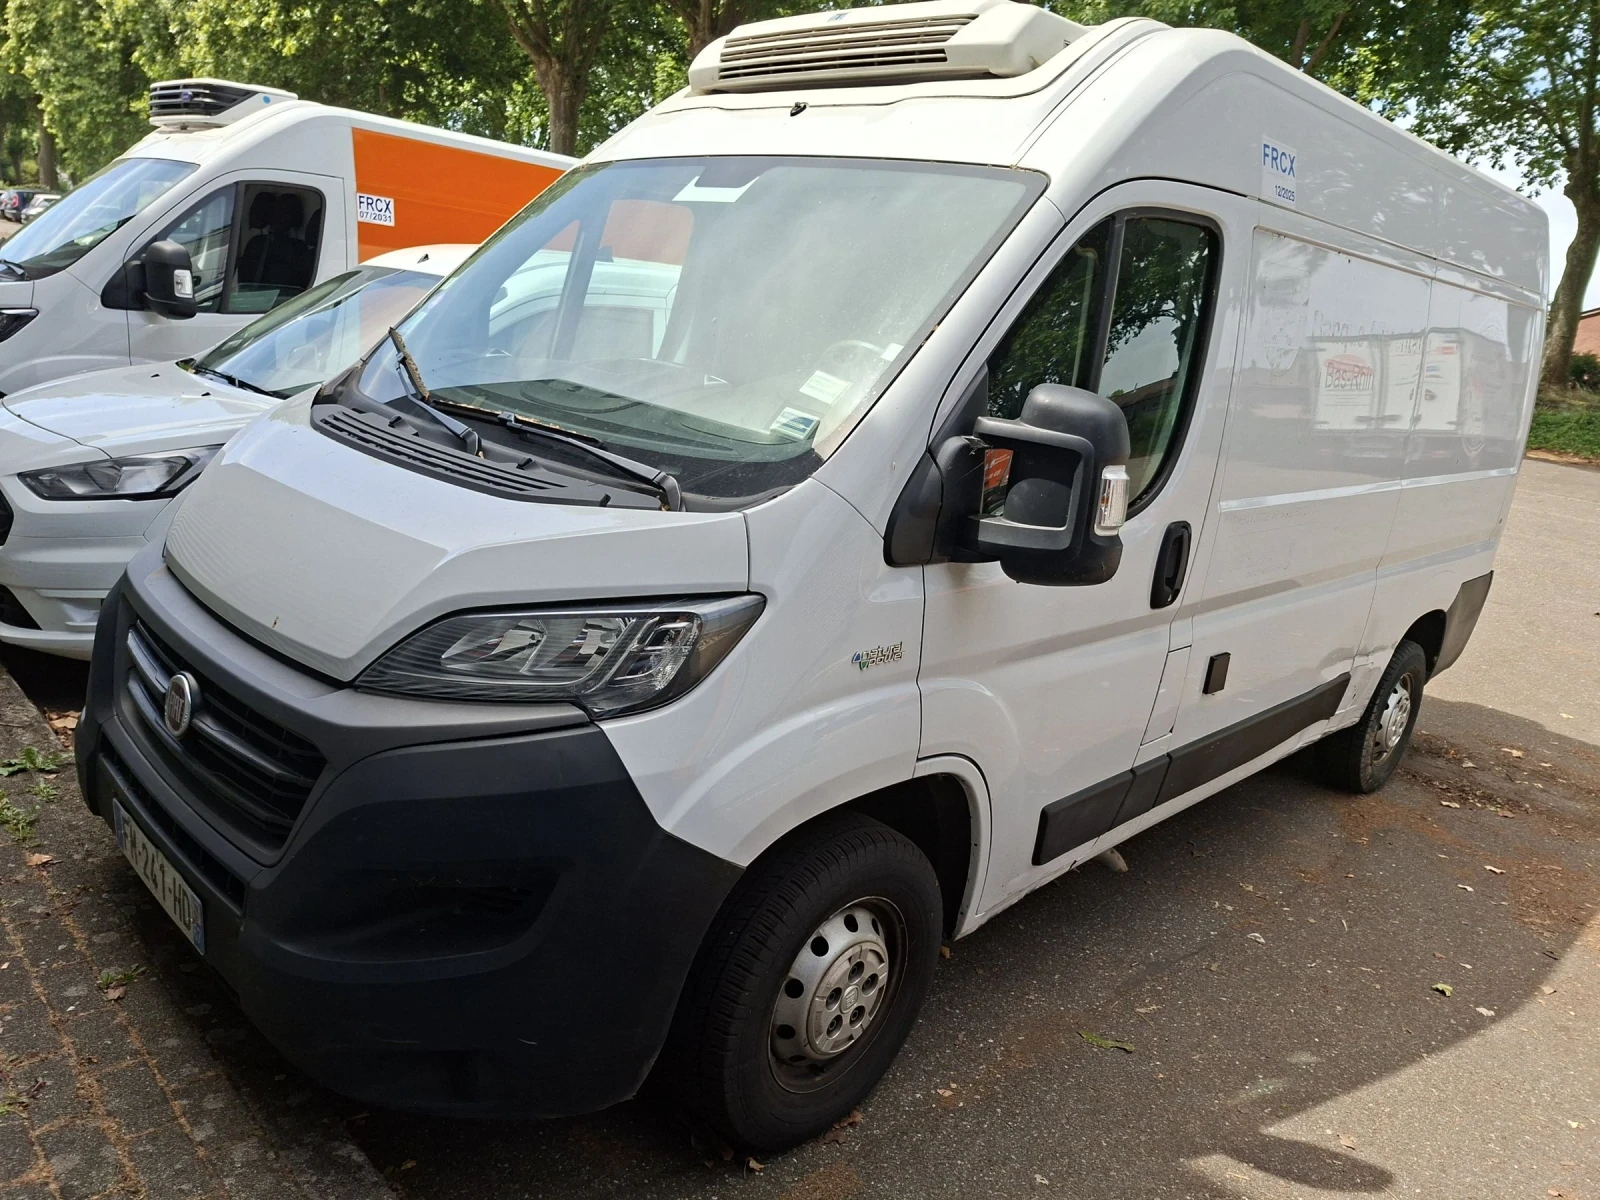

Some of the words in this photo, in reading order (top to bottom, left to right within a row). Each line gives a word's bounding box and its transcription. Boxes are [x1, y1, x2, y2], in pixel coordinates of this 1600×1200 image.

[1262, 143, 1296, 178] FRCX
[1274, 185, 1295, 202] 12/2025
[358, 195, 392, 214] FRCX
[359, 210, 392, 223] 07/2031
